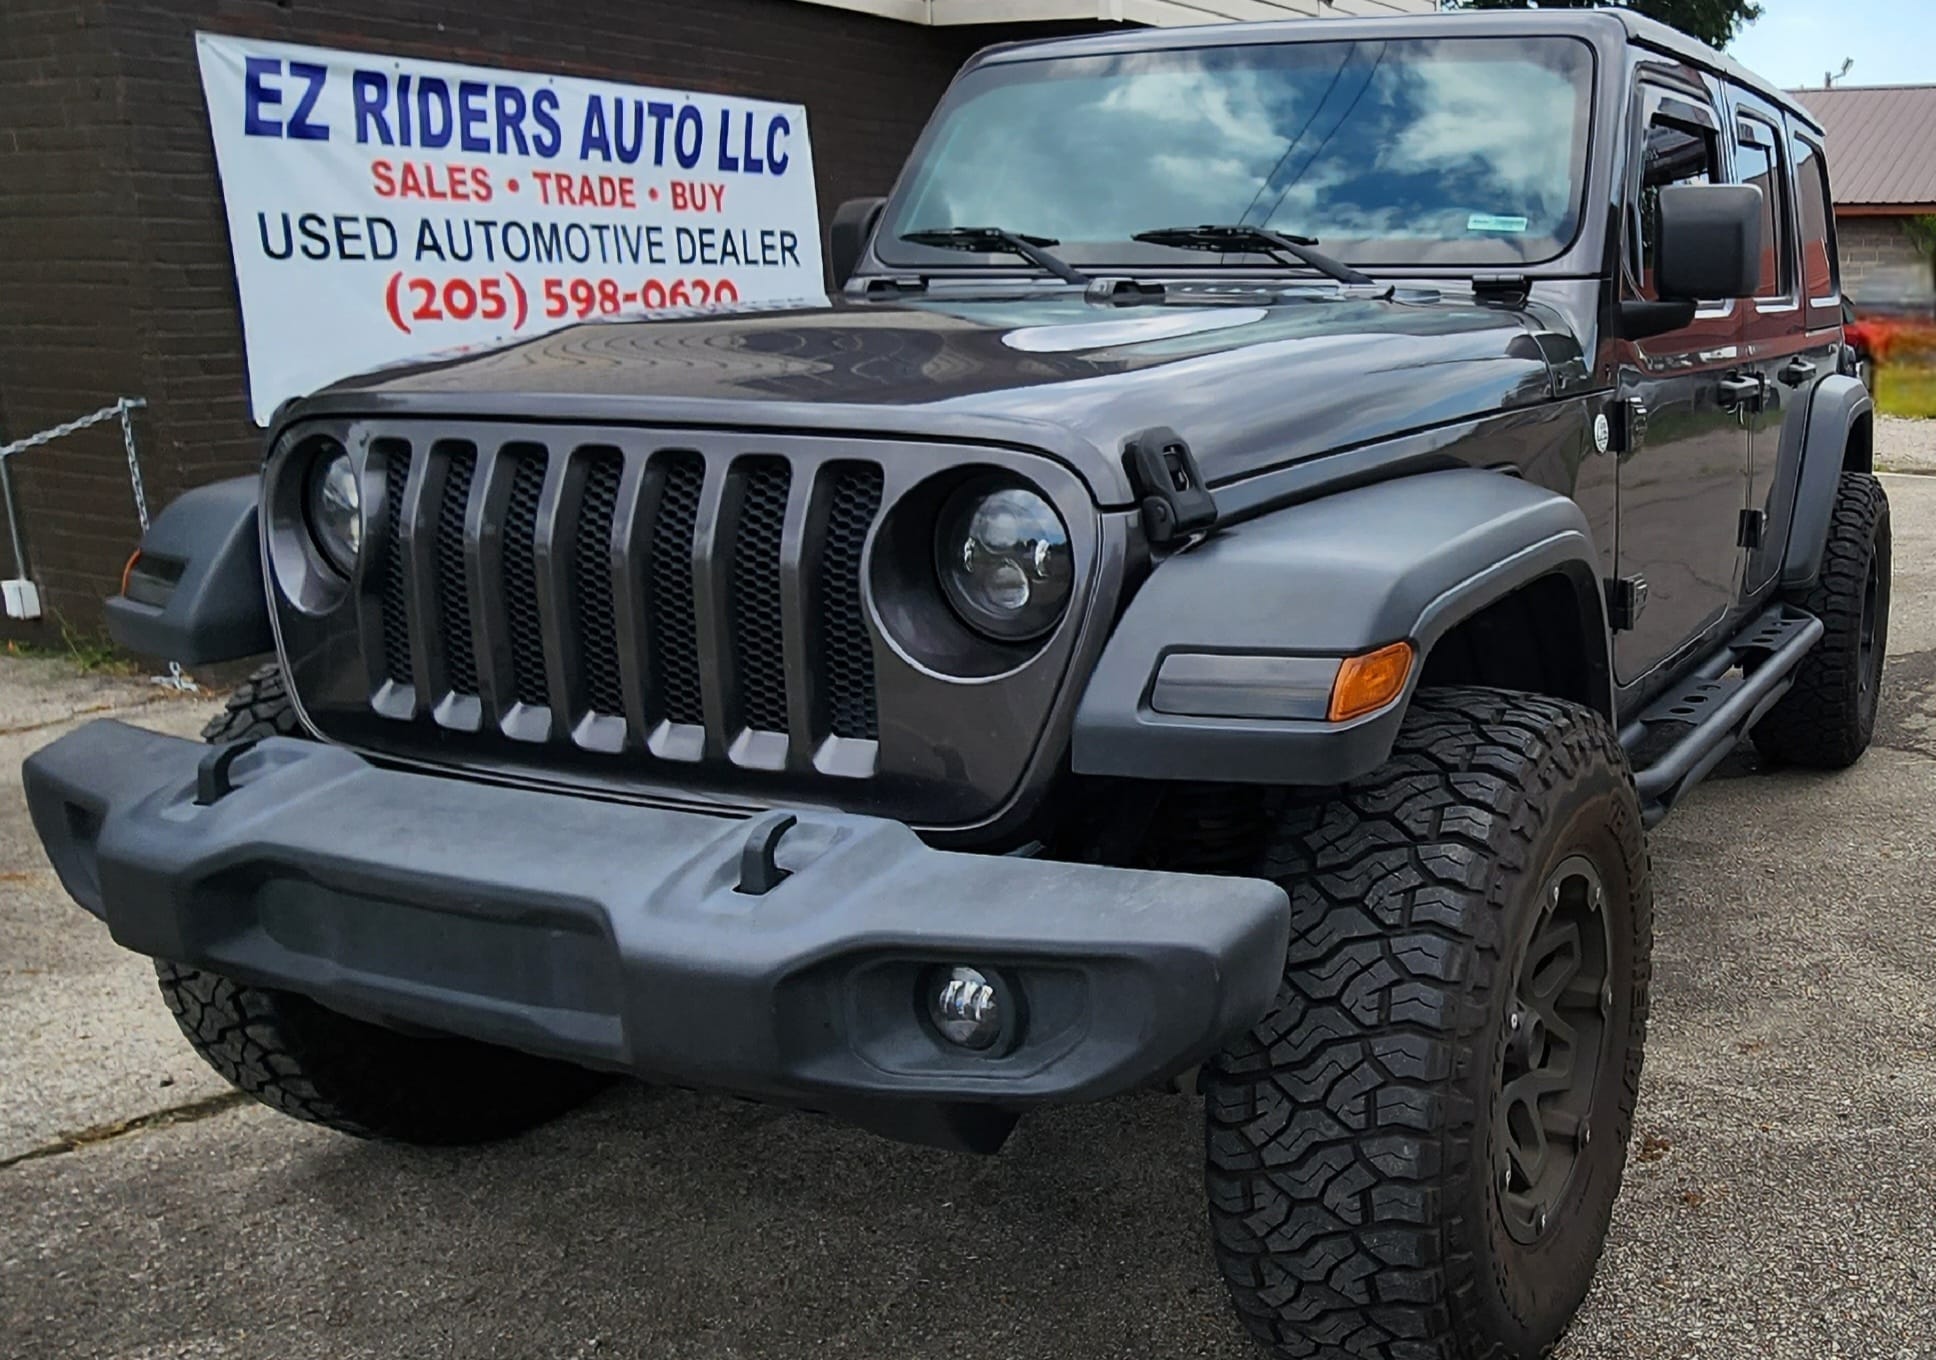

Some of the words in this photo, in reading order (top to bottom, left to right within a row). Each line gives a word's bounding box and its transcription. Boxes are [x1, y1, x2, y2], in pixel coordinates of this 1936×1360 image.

[244, 56, 330, 142] EZ
[352, 70, 562, 159] RIDERS
[579, 94, 704, 169] AUTO
[718, 108, 791, 177] LLC
[372, 160, 492, 203] SALES
[533, 171, 636, 209] TRADE
[671, 181, 725, 213] BUY
[257, 212, 398, 261] USED
[415, 218, 667, 264] AUTOMOTIVE
[675, 226, 801, 267] DEALER
[385, 272, 528, 333] (205)
